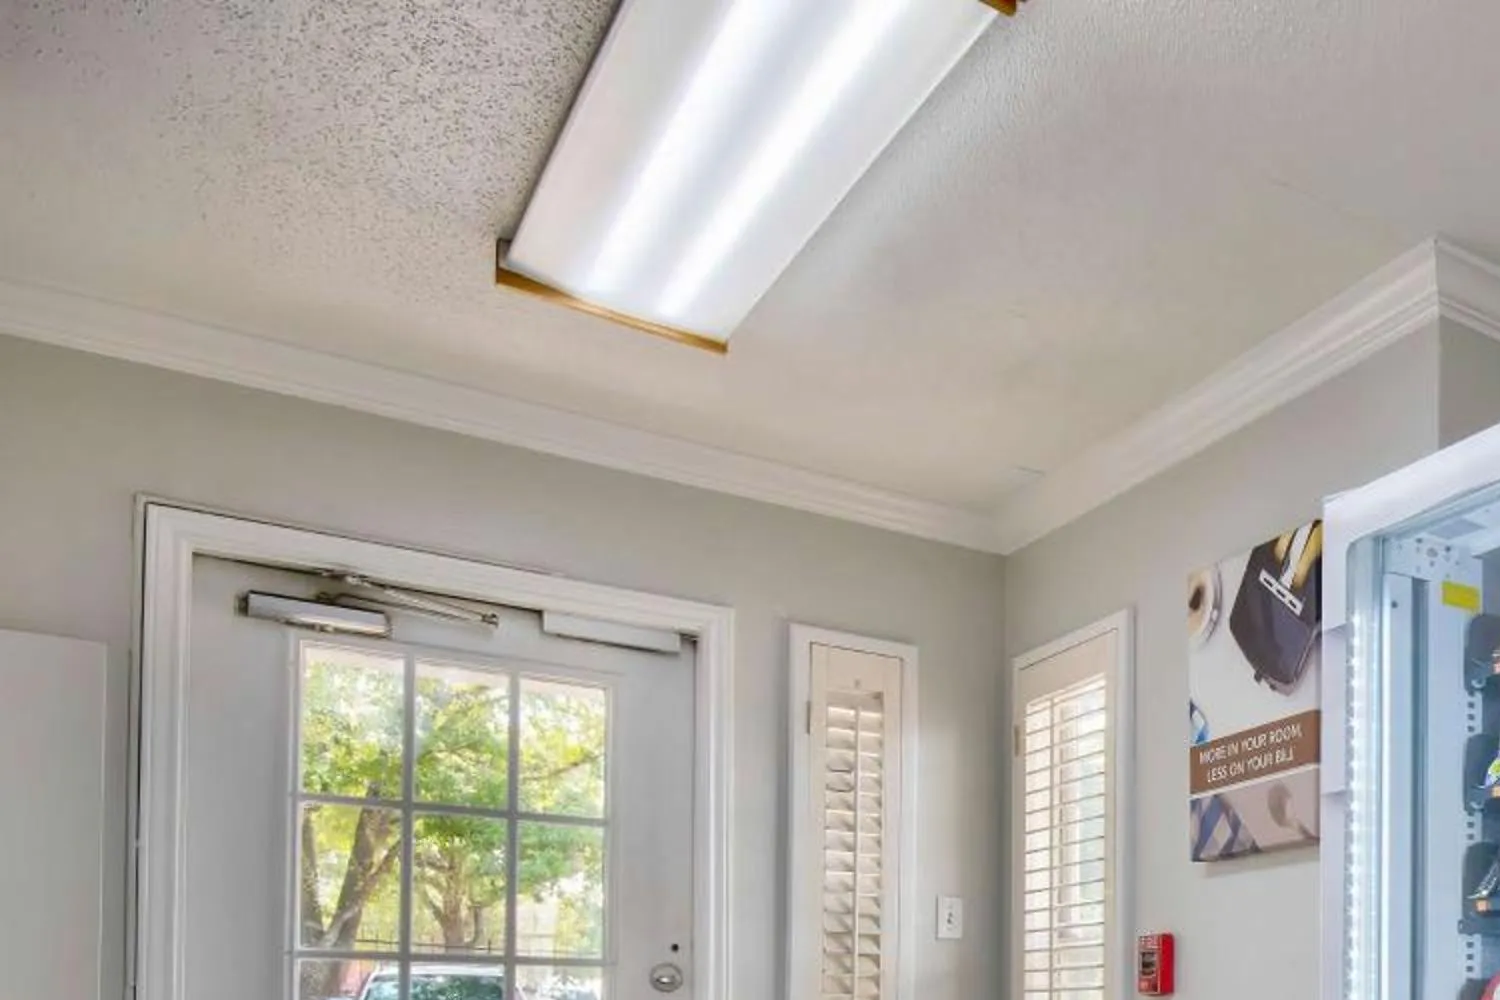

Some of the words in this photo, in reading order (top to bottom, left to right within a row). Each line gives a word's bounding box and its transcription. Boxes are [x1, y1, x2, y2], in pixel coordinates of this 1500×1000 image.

[1199, 746, 1227, 765] MORE
[1227, 741, 1240, 757] IN
[1240, 733, 1267, 751] YOUR
[1207, 764, 1227, 783] LESS
[1229, 758, 1245, 777] ON
[1247, 752, 1274, 772] YOUR
